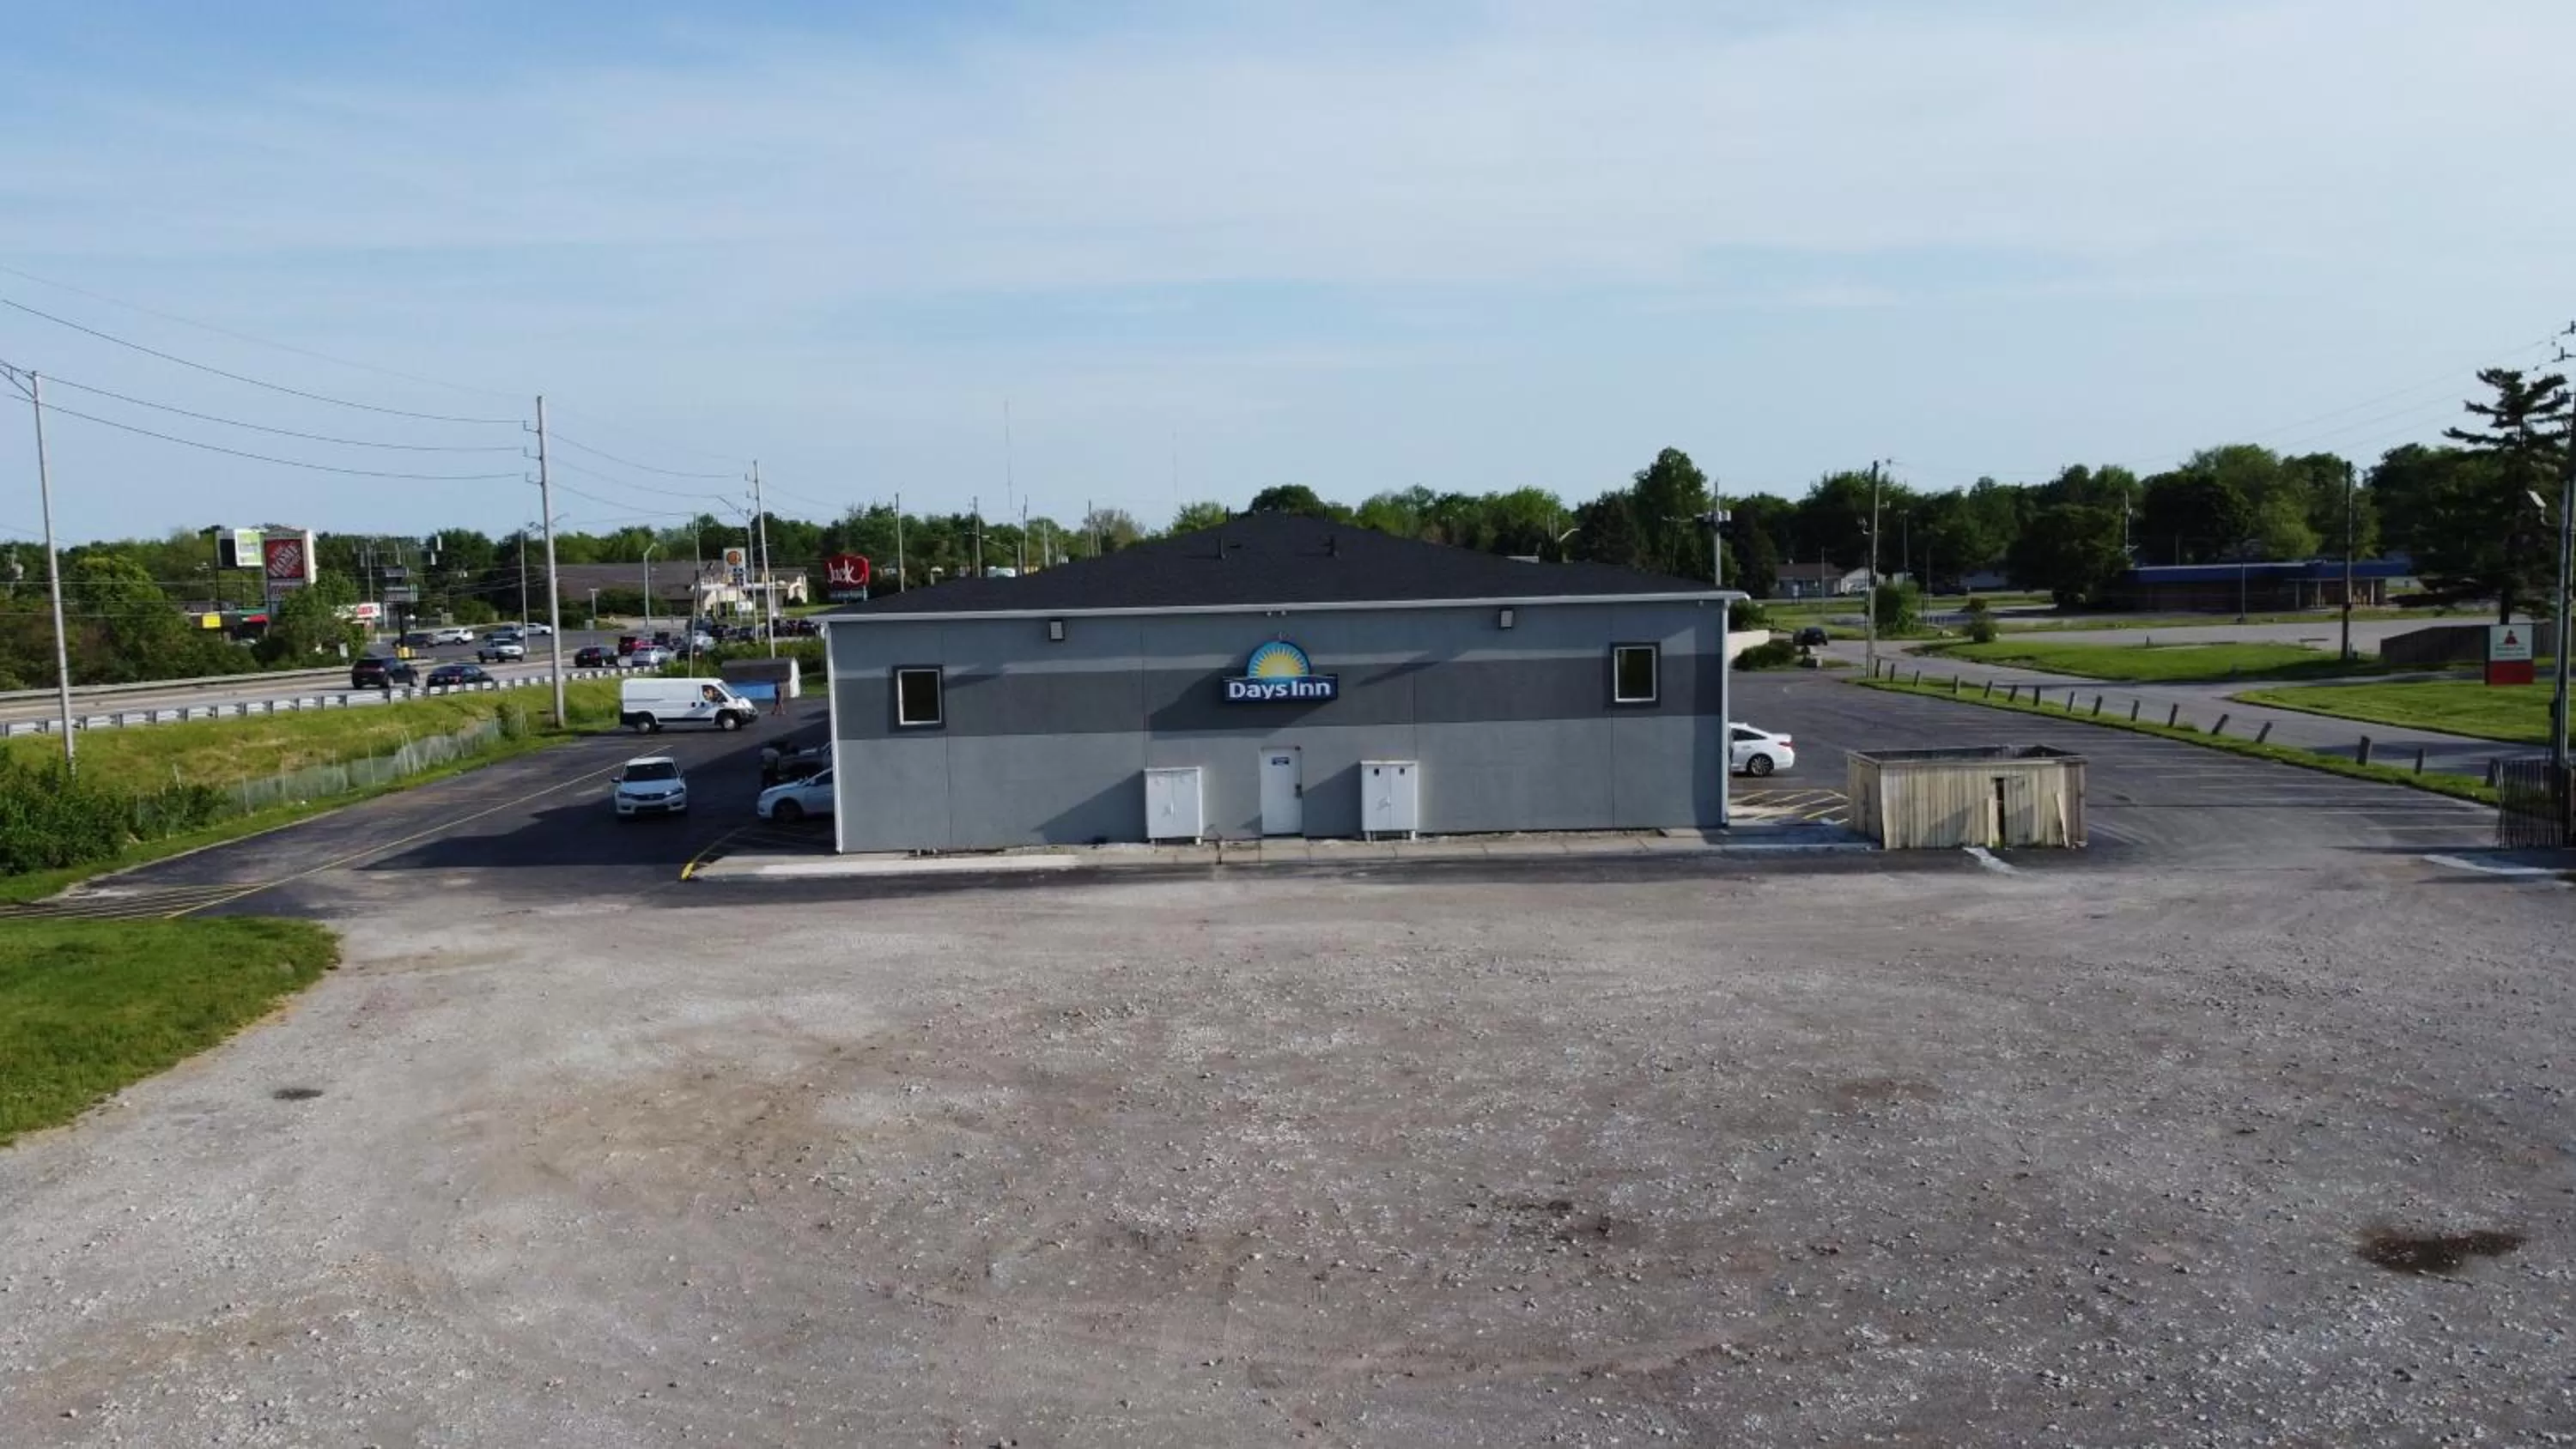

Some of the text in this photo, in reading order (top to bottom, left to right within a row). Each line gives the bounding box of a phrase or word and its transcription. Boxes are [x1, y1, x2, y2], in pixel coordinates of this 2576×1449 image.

[828, 559, 865, 584] Jack
[1229, 681, 1332, 700] Days Inn
